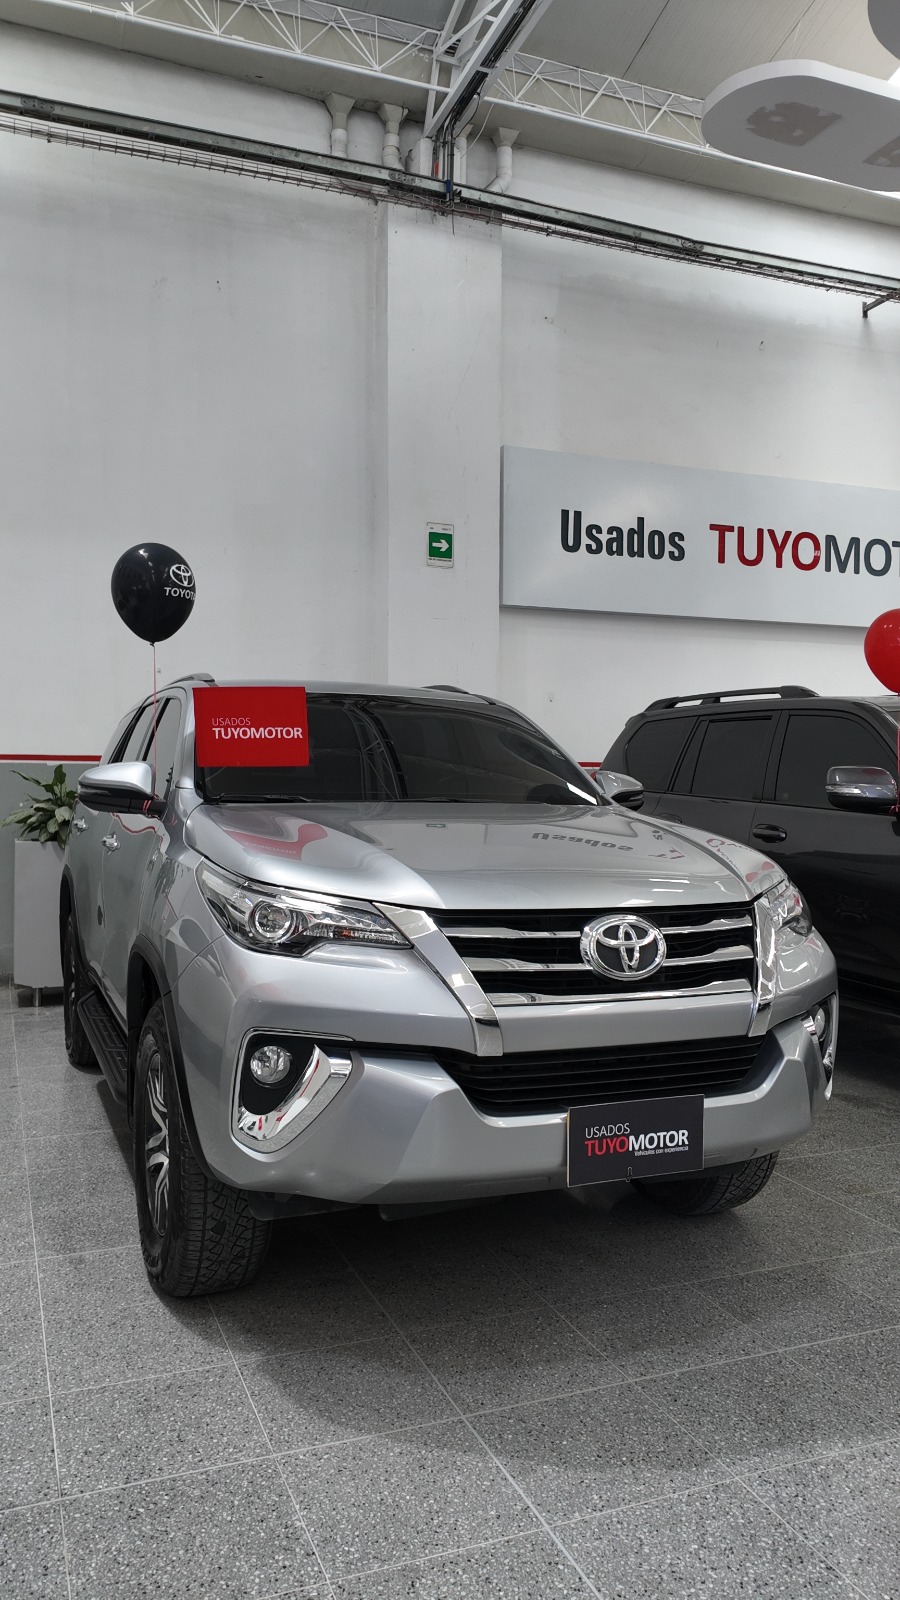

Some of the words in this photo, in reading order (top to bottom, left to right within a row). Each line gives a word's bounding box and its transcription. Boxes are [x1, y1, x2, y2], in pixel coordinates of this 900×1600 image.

[560, 509, 686, 562] Usados
[211, 717, 251, 726] USADOS
[212, 727, 303, 739] TUYOMOTOR
[585, 1122, 631, 1139] USADOS
[584, 1129, 688, 1157] TUYOMOTOR
